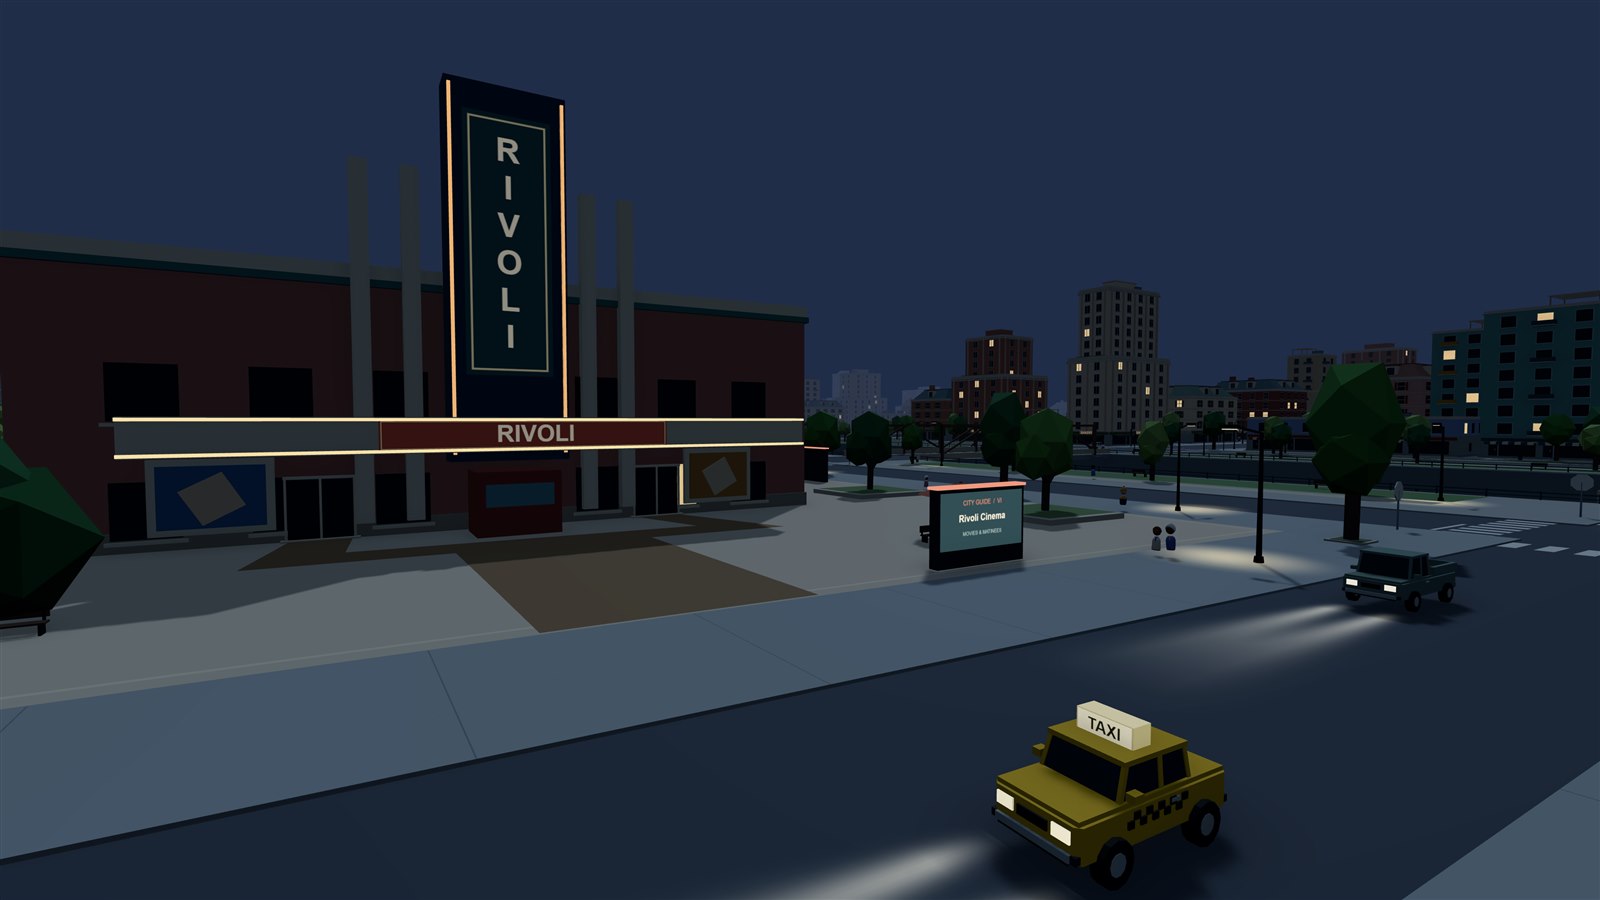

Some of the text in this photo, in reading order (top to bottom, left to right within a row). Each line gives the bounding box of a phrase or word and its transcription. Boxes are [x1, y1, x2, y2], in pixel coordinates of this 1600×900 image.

[497, 136, 522, 349] RIVOLI
[497, 424, 575, 443] RIVOLI
[959, 512, 1005, 523] Rivoli Cinema
[1088, 715, 1120, 742] TAXI
